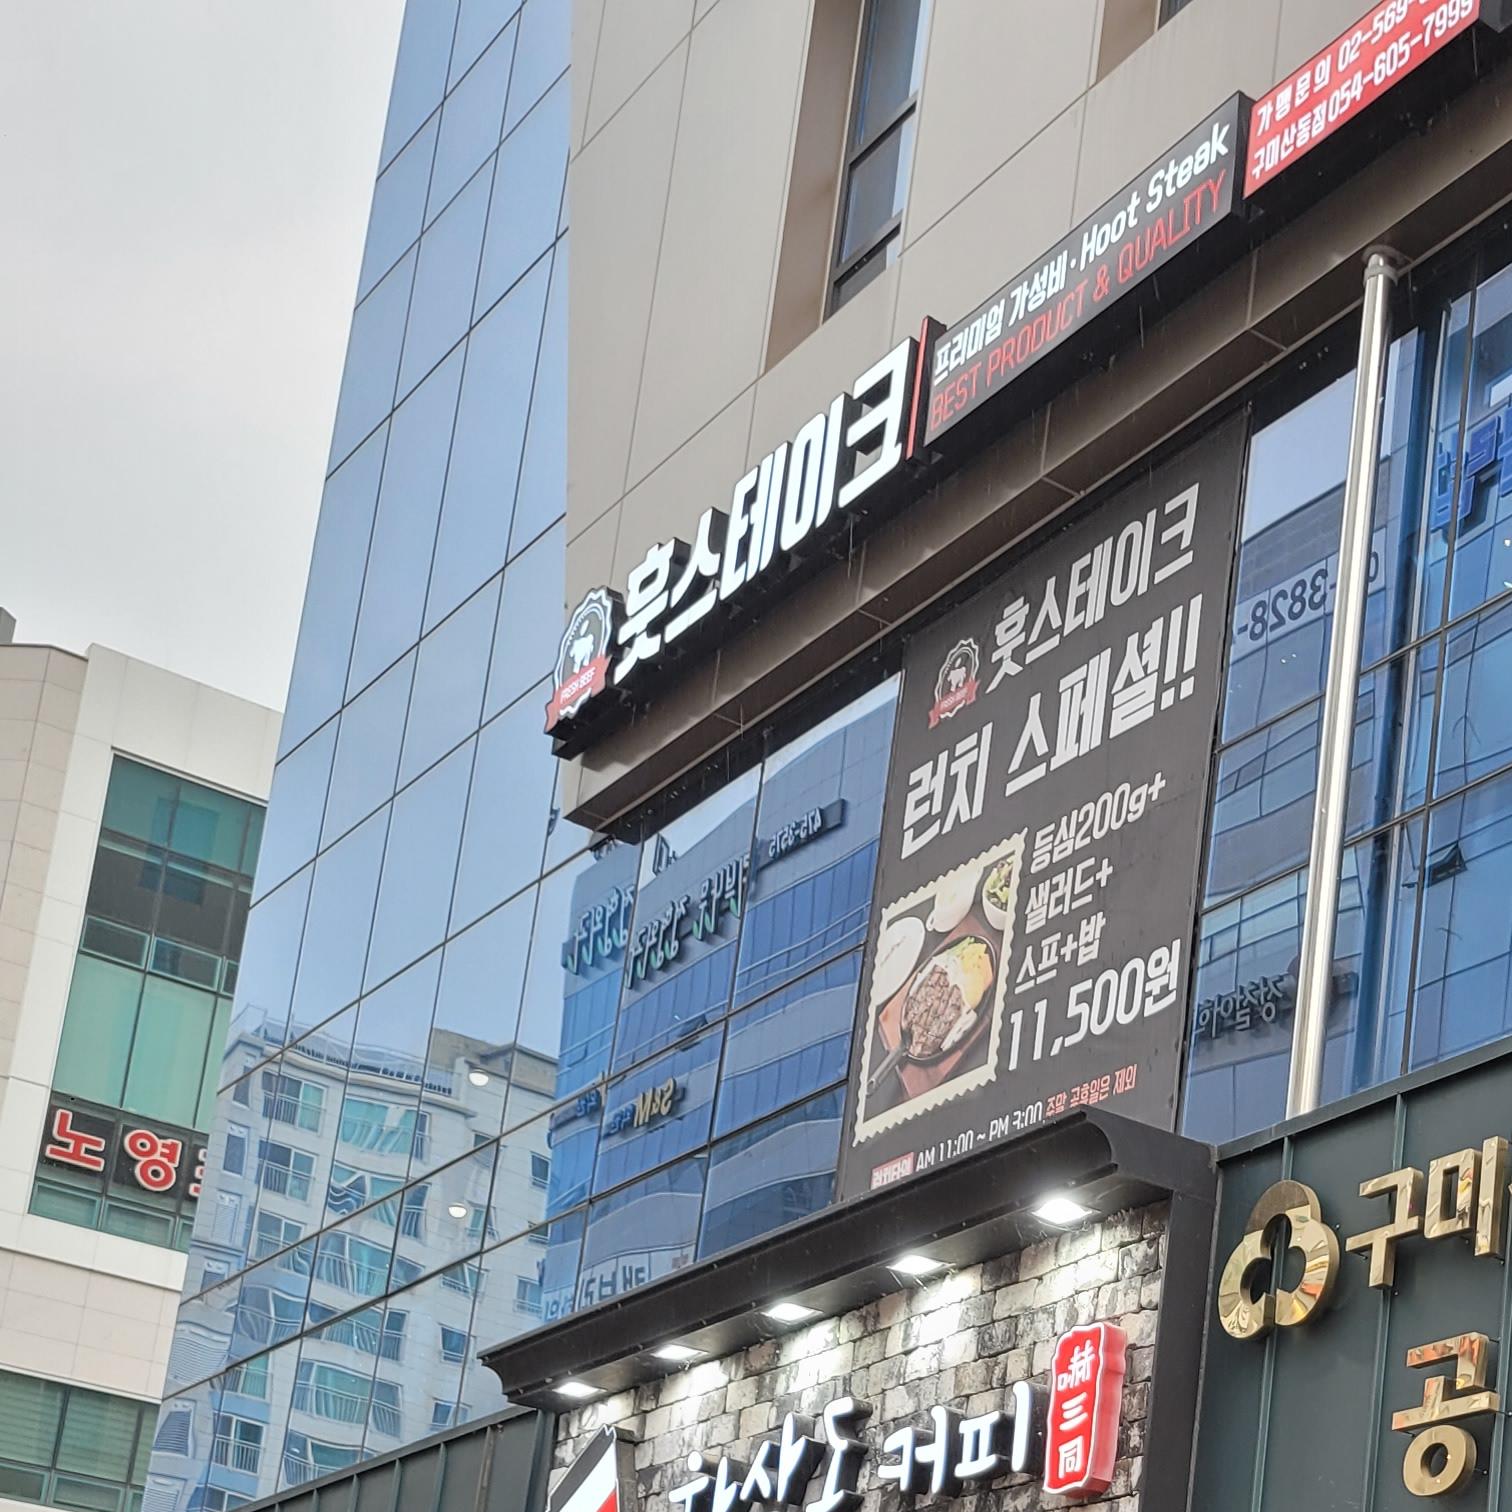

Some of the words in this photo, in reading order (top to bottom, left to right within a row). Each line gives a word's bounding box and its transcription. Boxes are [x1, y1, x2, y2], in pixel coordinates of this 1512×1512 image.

[930, 362, 981, 431] BEST
[986, 279, 1088, 388] PRODUCT
[1092, 263, 1110, 303] &
[1117, 168, 1227, 284] QUALITY
[933, 299, 1004, 386] 프리미엄
[1008, 250, 1068, 328] 가성비
[1080, 190, 1141, 272] Hoot
[1146, 122, 1230, 213] Steak
[613, 336, 912, 686] 훗스테이크
[985, 482, 1199, 694] 훗스테이크
[901, 721, 994, 860] 런치
[1005, 593, 1203, 797] 스페셜!!
[1030, 771, 1167, 874] 등심200g+
[1024, 857, 1114, 934] 샐러드+
[1008, 938, 1181, 1072] 11,500원
[45, 1108, 206, 1200] 노영
[915, 1148, 936, 1172] AM
[938, 1133, 973, 1162] 11:00
[988, 1116, 1010, 1143] PM
[877, 1381, 1031, 1494] 커피
